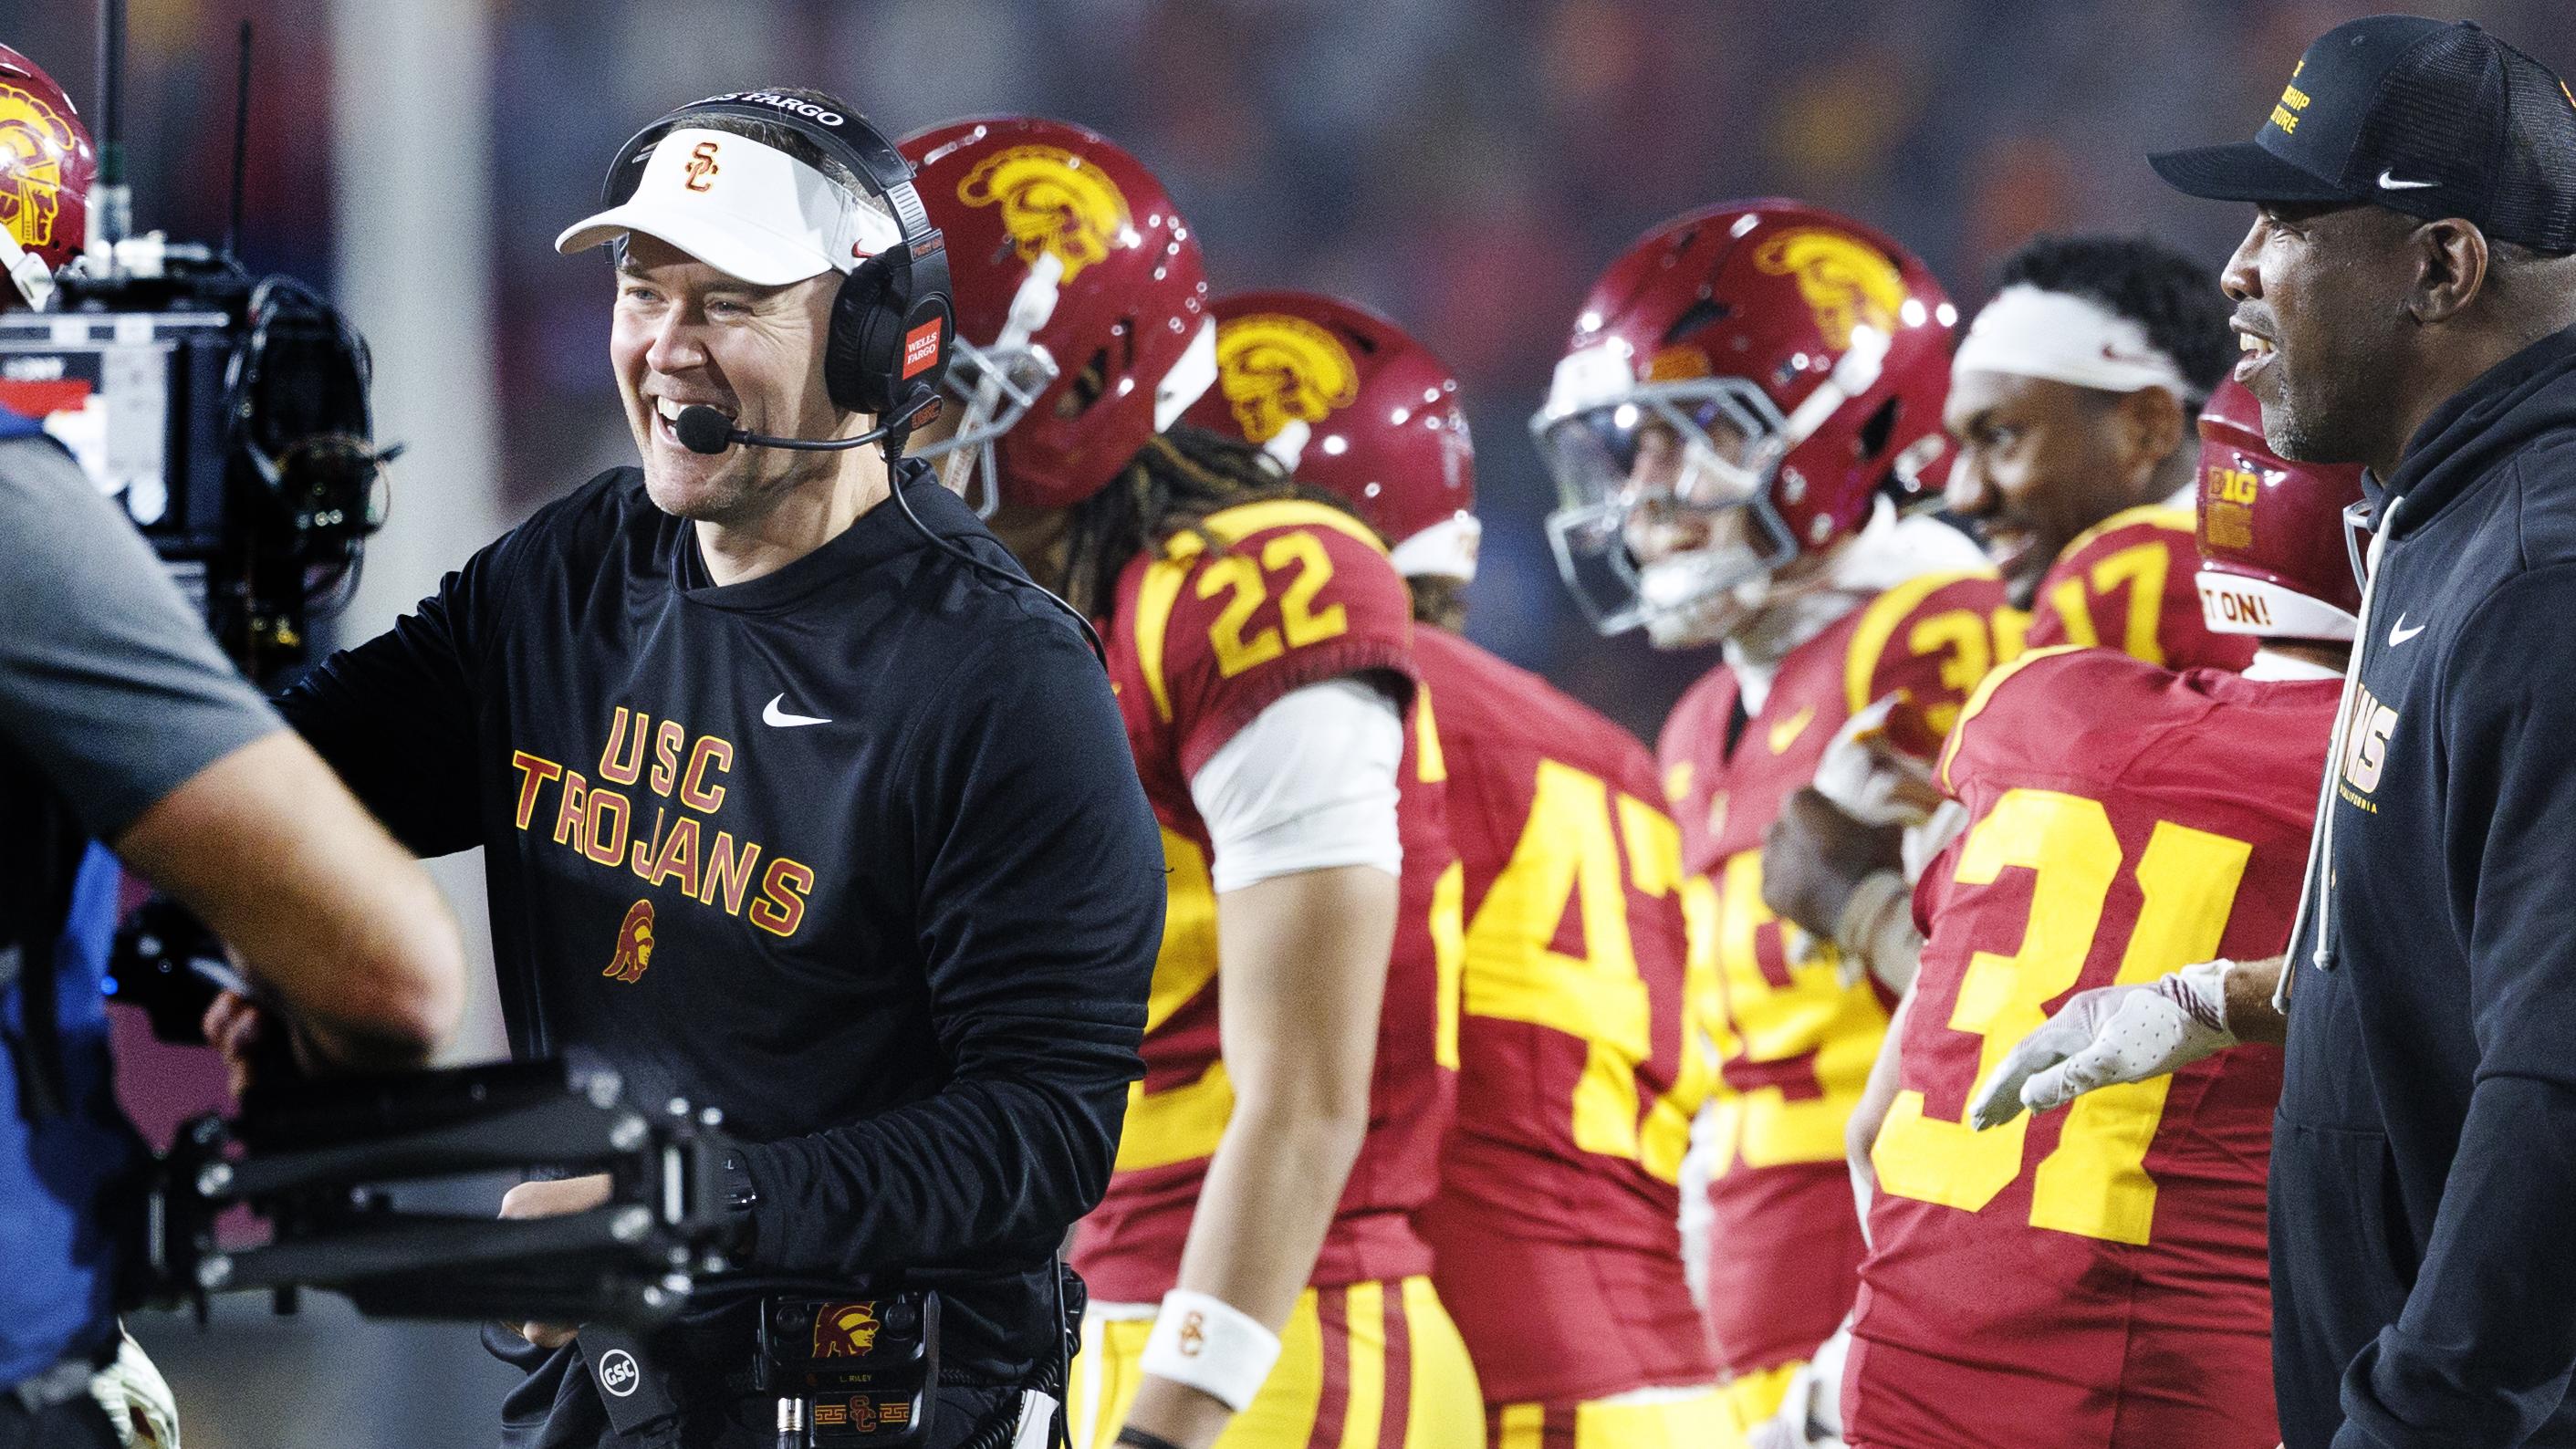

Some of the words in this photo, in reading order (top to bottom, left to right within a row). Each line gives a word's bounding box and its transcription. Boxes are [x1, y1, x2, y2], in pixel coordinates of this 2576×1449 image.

[741, 92, 844, 126] FARGO
[907, 343, 936, 365] FARGO
[908, 331, 937, 353] WELLS
[1195, 531, 1348, 679] 22
[2053, 542, 2168, 666] 17
[2221, 592, 2272, 626] ON!
[599, 706, 734, 814] USC
[2341, 682, 2399, 794] NS
[512, 749, 815, 937] TROJANS
[1871, 787, 2254, 1246] 31
[604, 1360, 635, 1385] GSC
